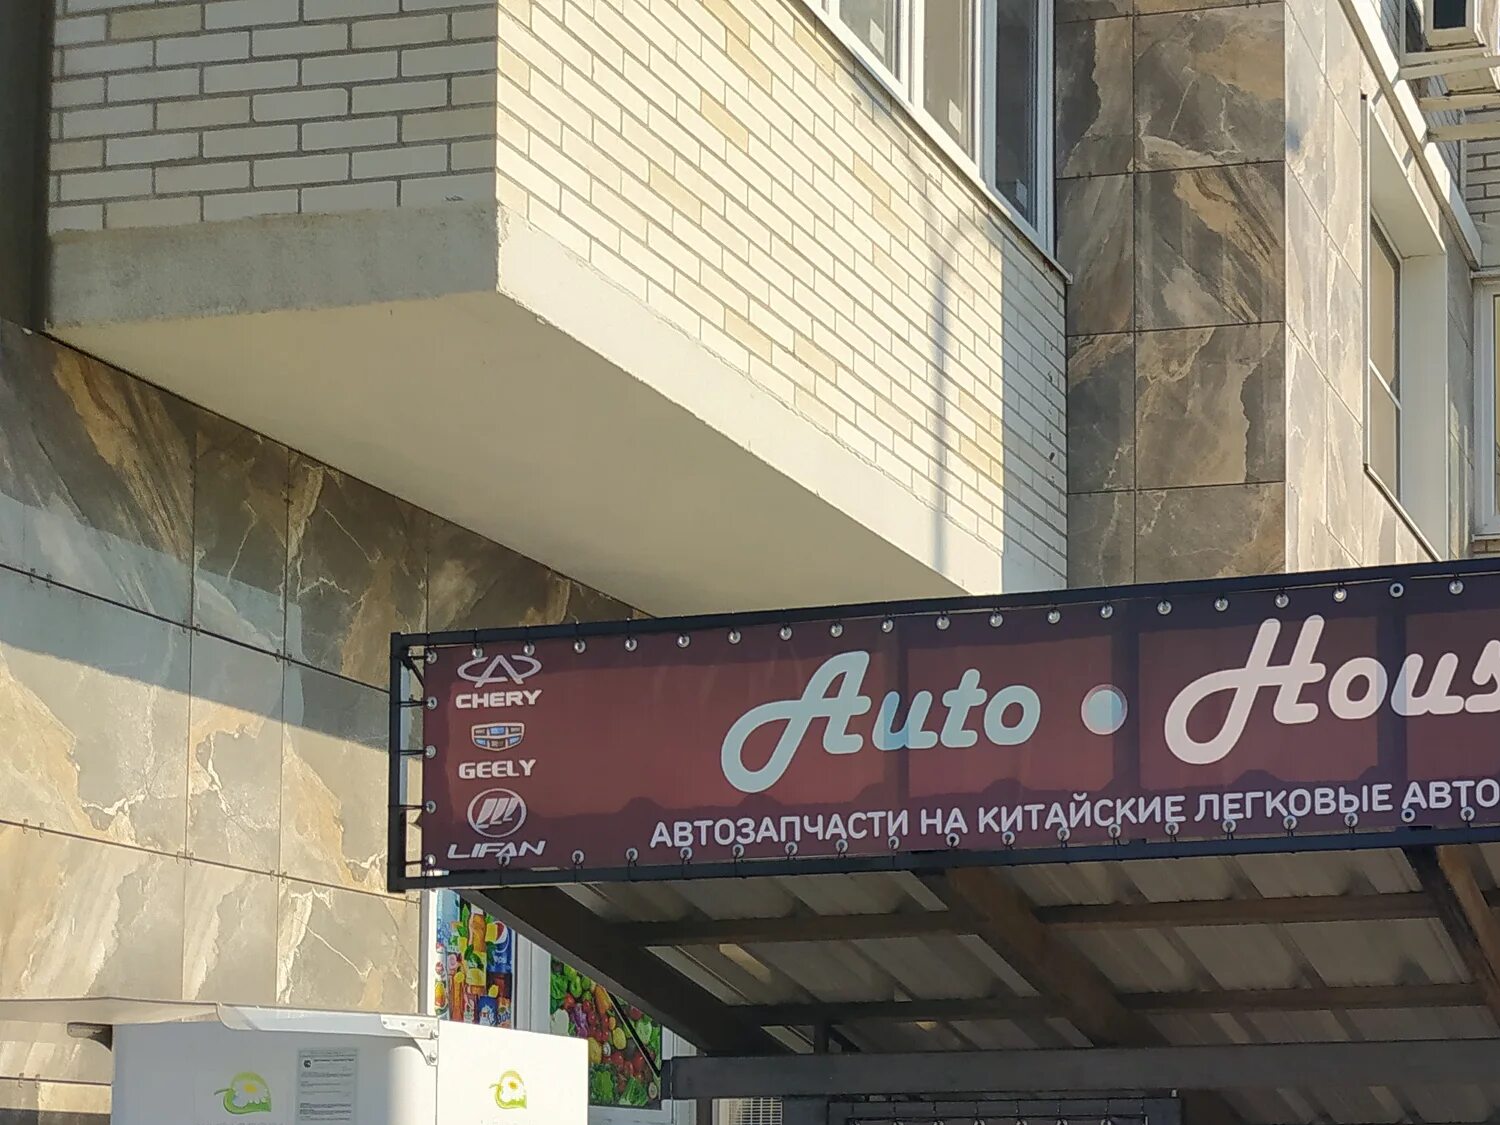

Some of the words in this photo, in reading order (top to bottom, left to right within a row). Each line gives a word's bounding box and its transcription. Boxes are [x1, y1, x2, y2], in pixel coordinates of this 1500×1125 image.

[456, 690, 543, 709] CHERY
[720, 650, 1041, 793] Auto
[458, 758, 536, 779] GEELY
[650, 810, 909, 849] АВТОЗАПЧАСТИ
[921, 808, 968, 836] НА
[978, 791, 1191, 833] КИТАЙСКИЕ
[1194, 783, 1392, 823] ЛЕГКОВЫЕ
[447, 840, 546, 860] LIFAN
